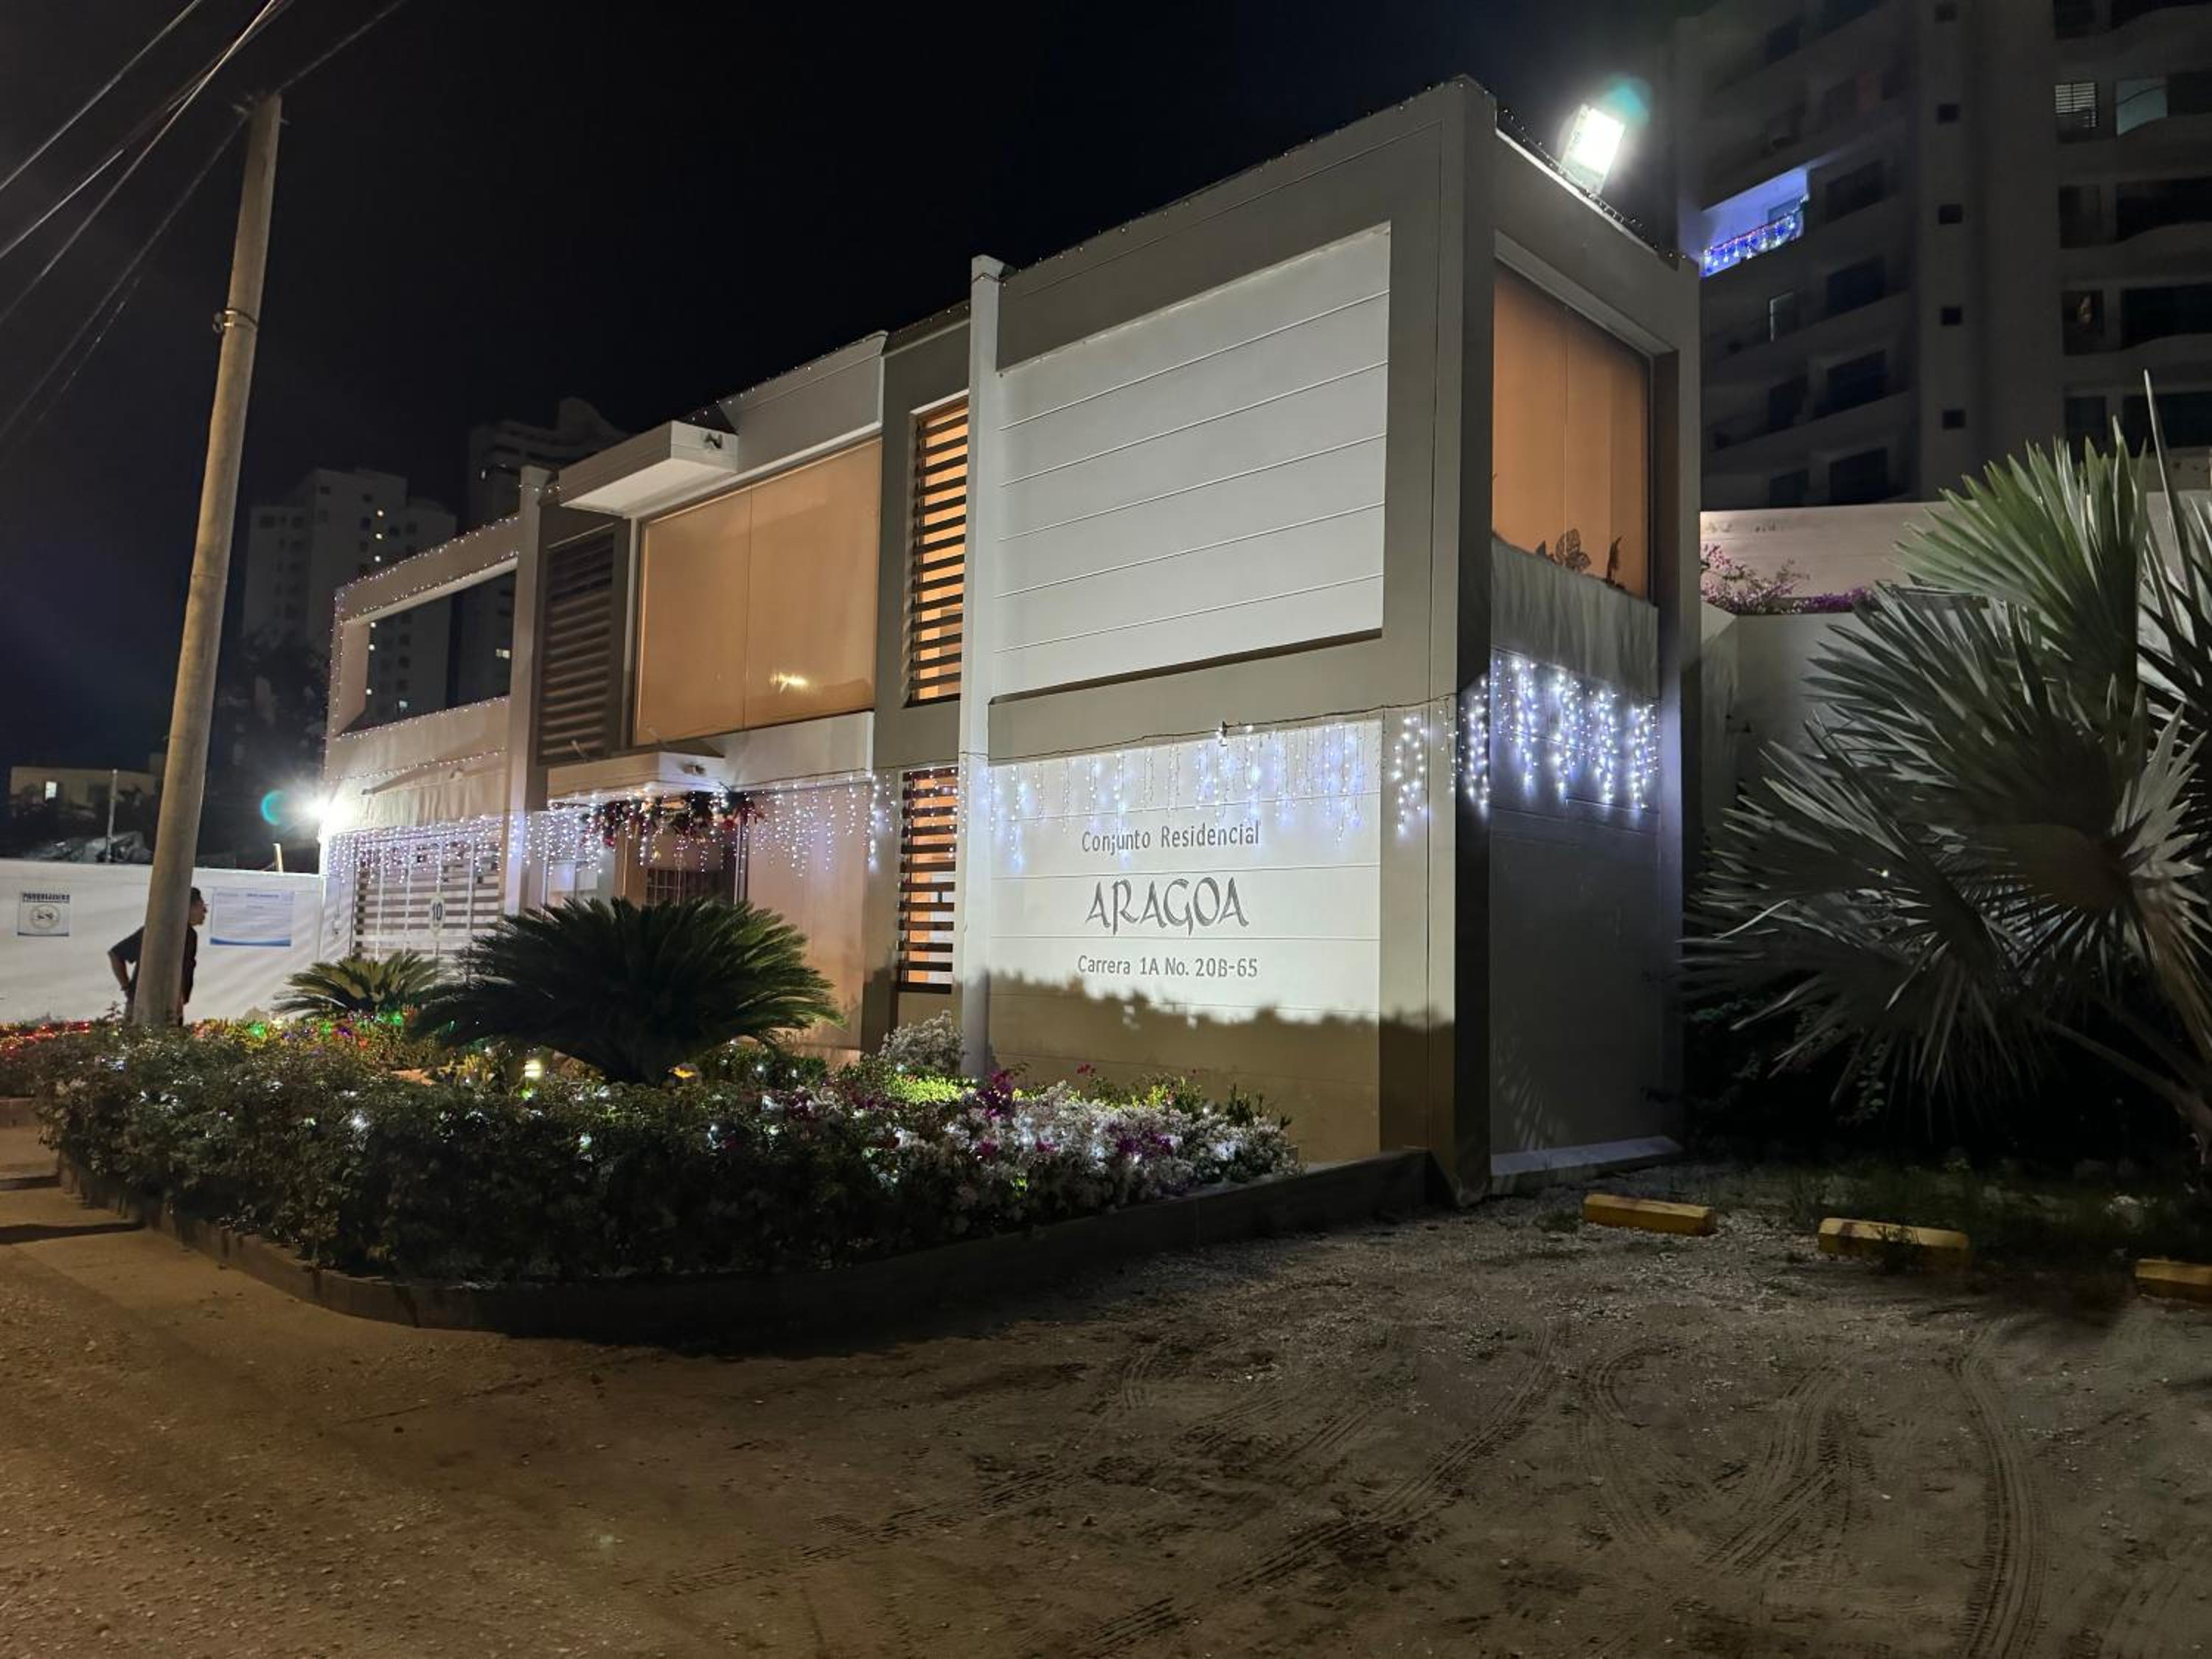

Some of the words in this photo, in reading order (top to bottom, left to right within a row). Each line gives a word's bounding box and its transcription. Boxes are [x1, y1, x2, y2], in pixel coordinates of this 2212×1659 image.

[1082, 830, 1151, 855] Conjunto
[1161, 822, 1260, 848] Residencial
[432, 902, 443, 921] 10
[1085, 877, 1250, 936] ARAGOA
[1078, 955, 1131, 975] Carrera
[1140, 957, 1160, 975] 1A
[1165, 958, 1189, 976] No.
[1195, 958, 1258, 978] 20B-65
